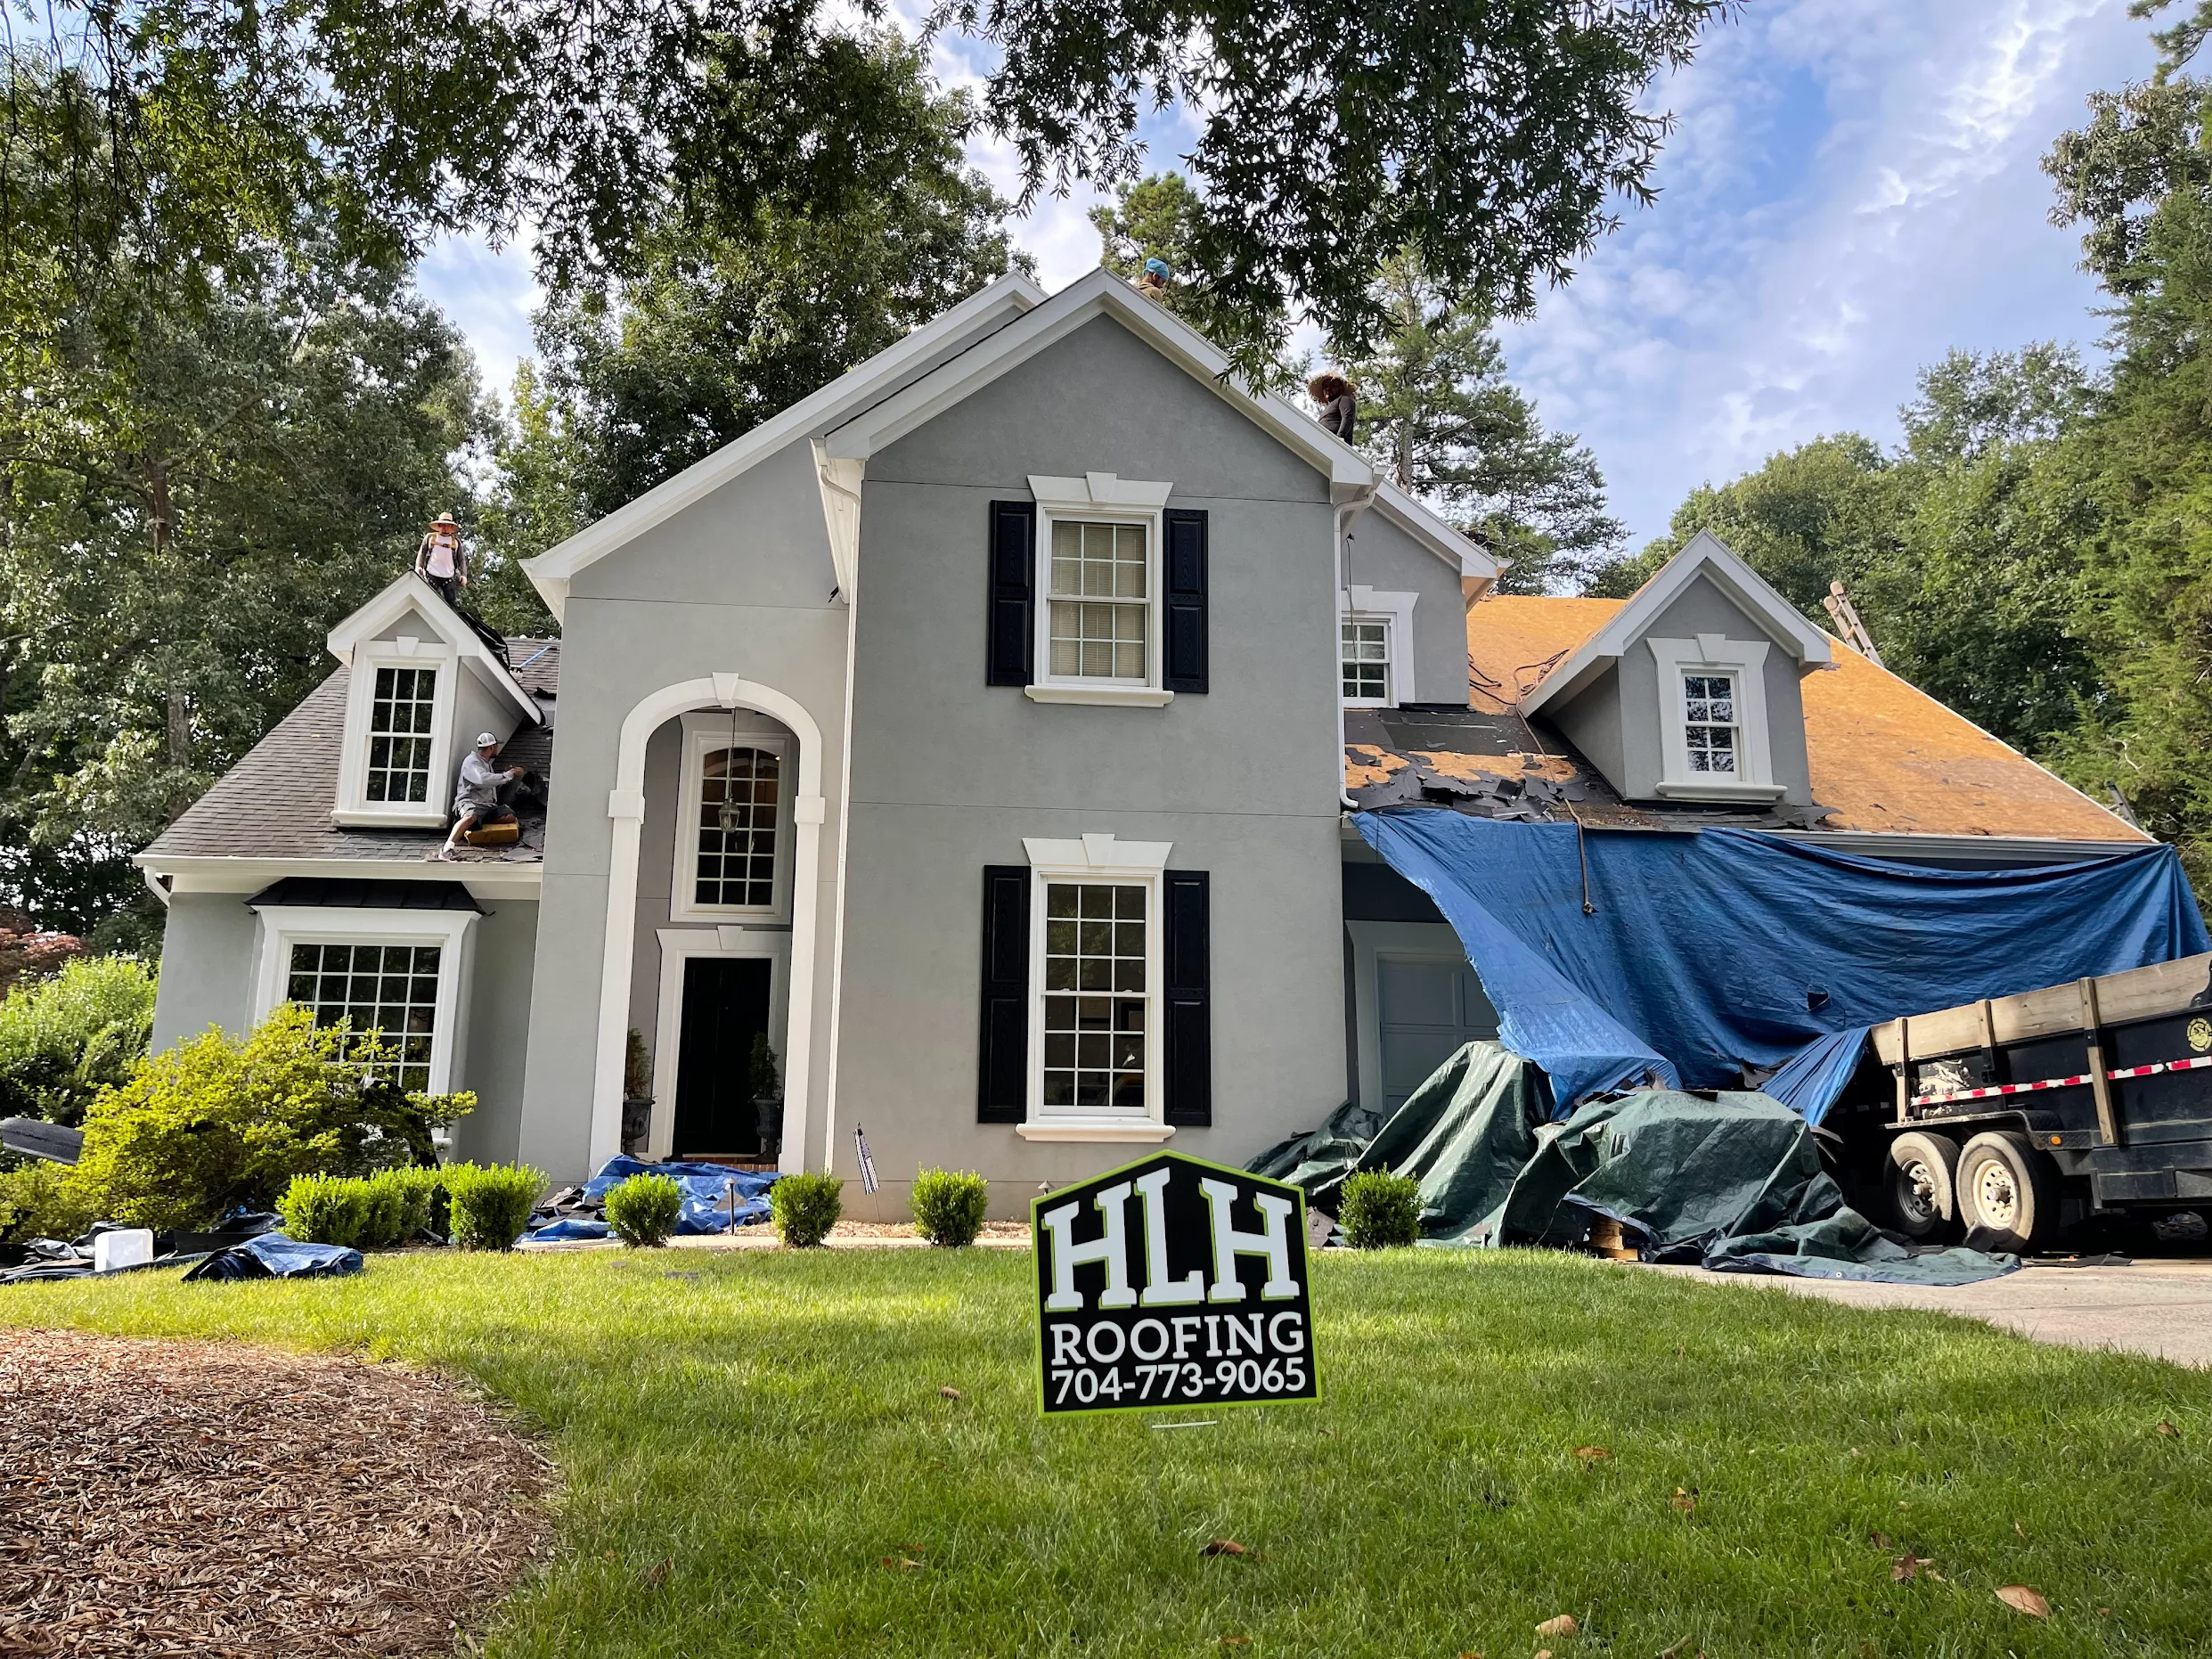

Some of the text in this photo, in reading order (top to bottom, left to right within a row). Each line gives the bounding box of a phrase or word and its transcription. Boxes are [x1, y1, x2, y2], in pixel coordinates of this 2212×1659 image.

[1041, 1167, 1300, 1312] HLH
[1050, 1312, 1304, 1366] ROOFING
[1051, 1357, 1306, 1404] 704-773-9065
